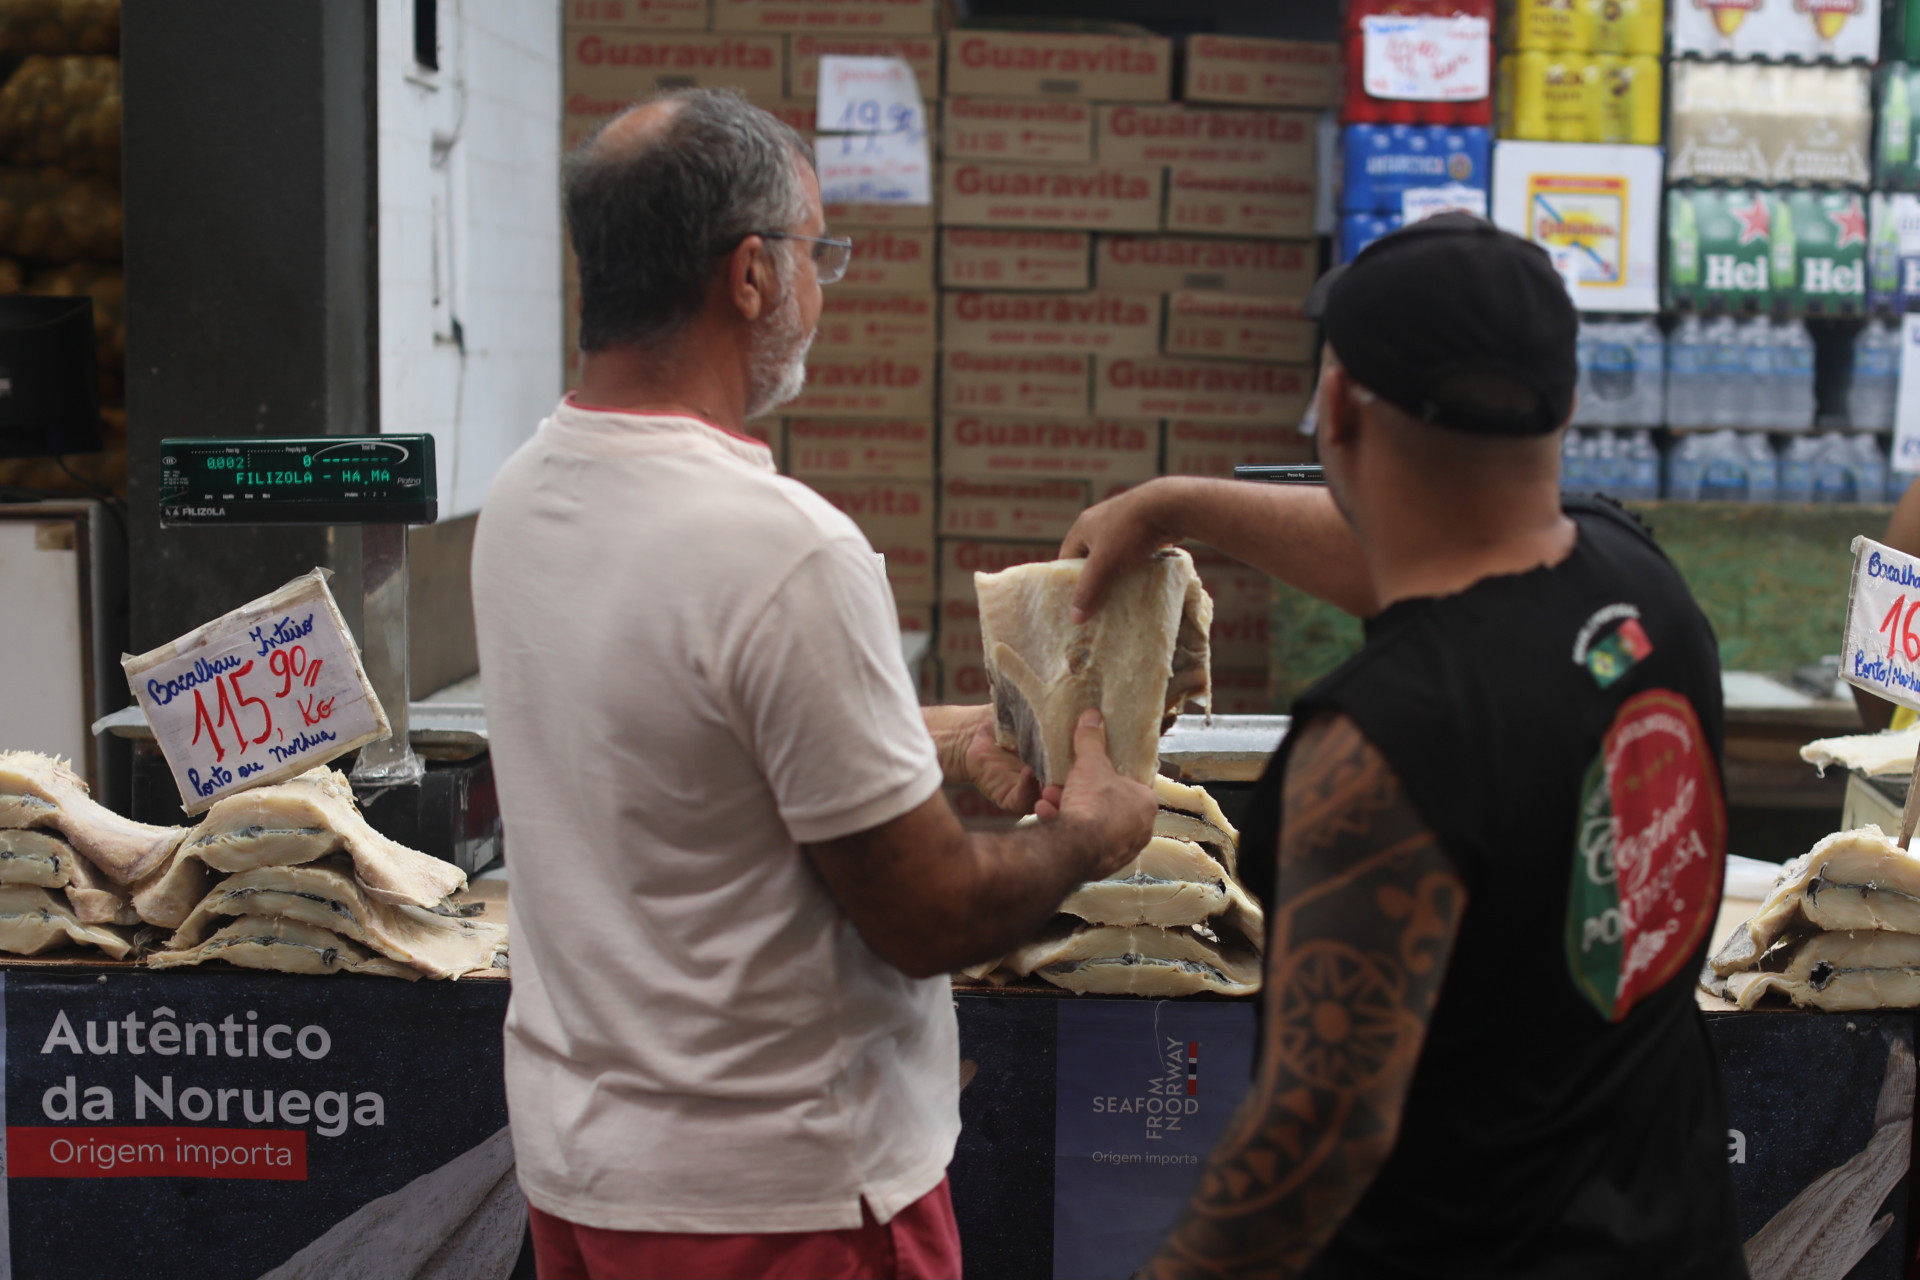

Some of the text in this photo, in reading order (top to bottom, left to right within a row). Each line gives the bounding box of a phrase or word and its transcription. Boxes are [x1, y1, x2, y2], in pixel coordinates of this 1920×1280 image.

[577, 35, 774, 70] Guaravita
[959, 38, 1158, 75] Guaravita
[1109, 106, 1306, 142] Guaravita
[955, 165, 1150, 200] Guaravita
[1109, 236, 1303, 270] Guaravita
[956, 291, 1147, 326] Guaravita
[1107, 360, 1300, 394] Guaravita
[954, 416, 1147, 450] Guaravita
[236, 472, 313, 485] FILIZOLA
[182, 507, 226, 517] FILIZOLA
[147, 653, 241, 705] Bacalhau
[187, 764, 233, 797] Porto
[40, 1006, 332, 1060] Autêntico
[1166, 1036, 1184, 1131] NORWAY
[41, 1075, 386, 1137] da Noruega
[1092, 1096, 1199, 1115] SEAFOOD
[49, 1137, 293, 1170] Origem importa
[1092, 1151, 1198, 1166] Origem importa
